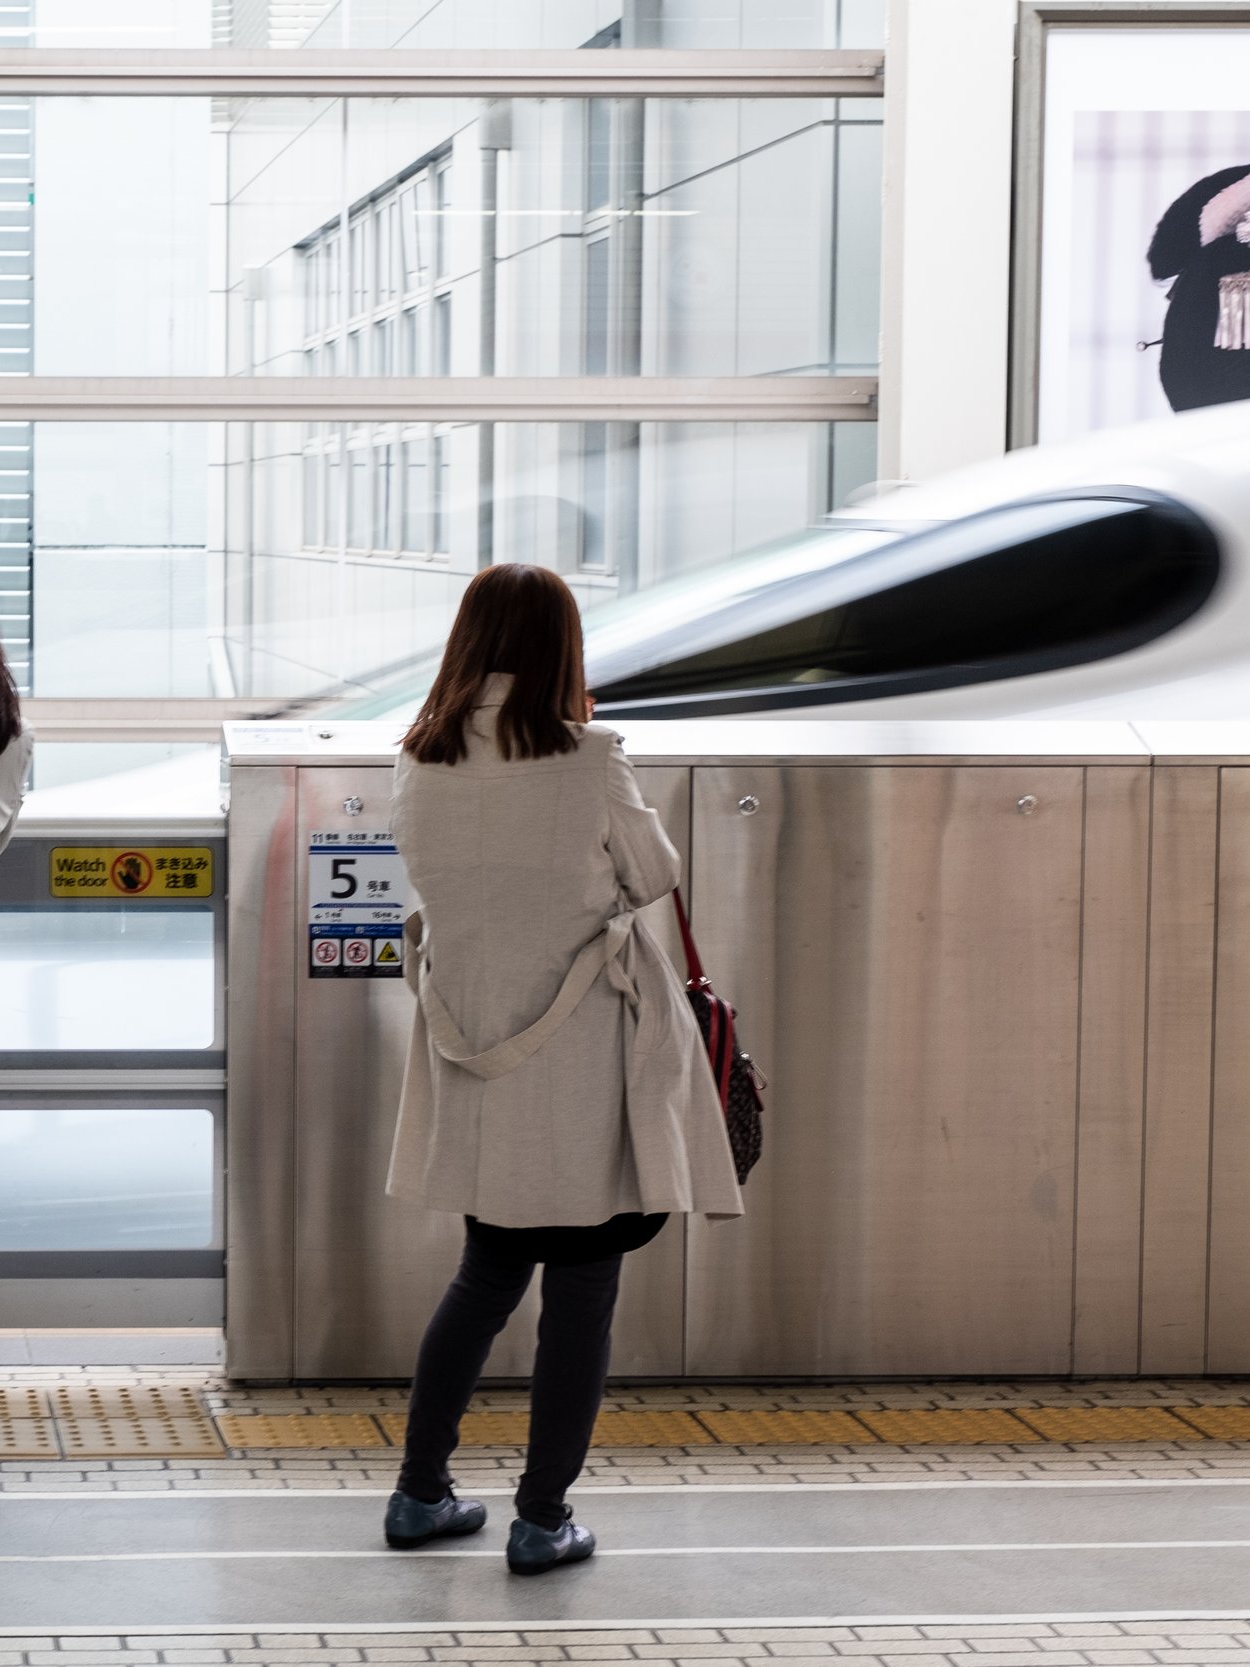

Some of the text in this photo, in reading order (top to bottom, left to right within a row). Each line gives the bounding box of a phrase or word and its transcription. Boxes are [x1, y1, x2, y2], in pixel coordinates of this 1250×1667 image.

[55, 858, 106, 873] Watch
[154, 857, 208, 871] まき込み
[54, 875, 108, 888] the door
[164, 873, 199, 889] 注意
